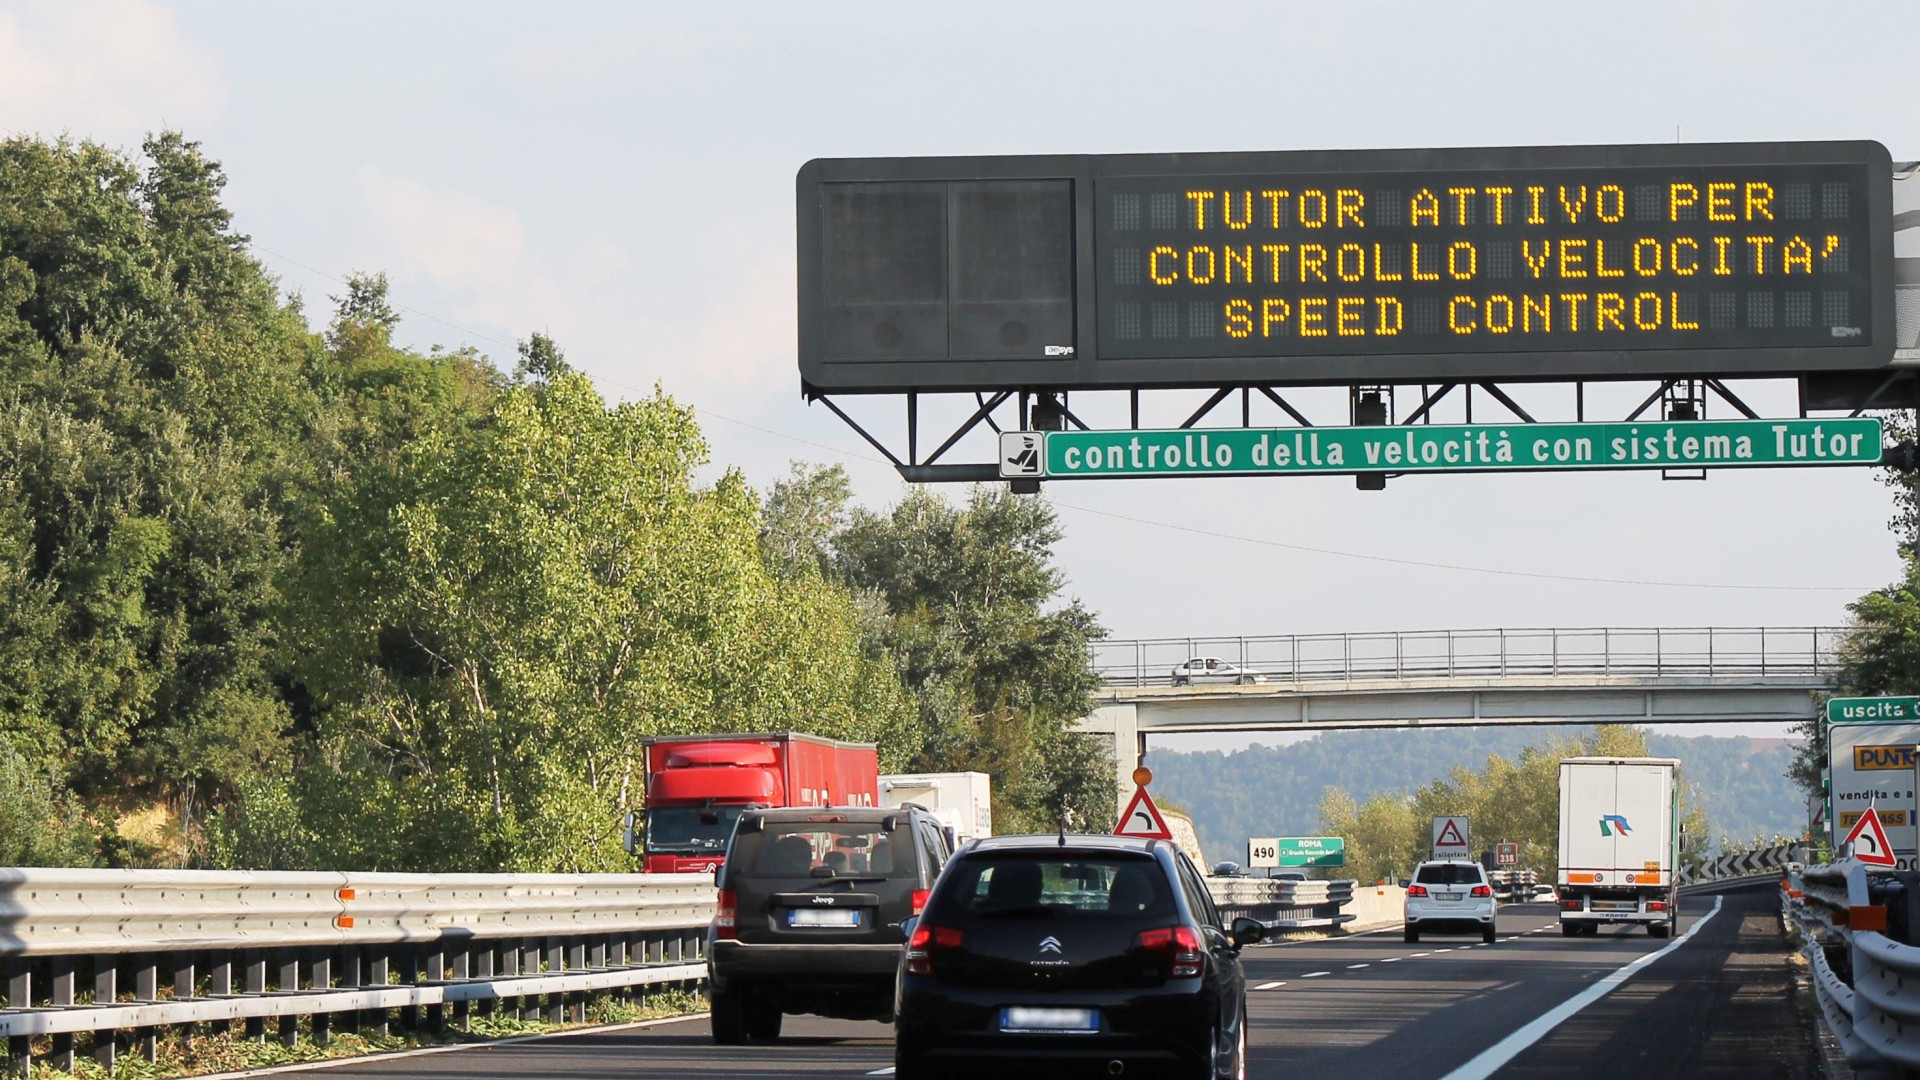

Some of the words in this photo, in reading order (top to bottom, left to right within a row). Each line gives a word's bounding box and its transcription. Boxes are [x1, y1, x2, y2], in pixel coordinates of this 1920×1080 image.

[1186, 188, 1365, 230] TUTOR
[1411, 184, 1625, 227] ATTIVO
[1670, 182, 1774, 222] PER
[1150, 241, 1477, 286] CONTROLLO
[1225, 296, 1403, 338] SPEED
[1449, 292, 1699, 335] CONTROL
[1064, 435, 1233, 470] controllo
[1252, 433, 1344, 466] della
[1364, 430, 1513, 464] velocità
[1532, 438, 1592, 461] con
[1611, 428, 1753, 460] sistema
[1772, 425, 1863, 458] Tutor
[1843, 702, 1904, 718] uscita
[1838, 789, 1888, 800] vendita
[1893, 790, 1901, 799] e
[1298, 839, 1323, 848] ROMA
[1253, 847, 1275, 859] 490
[1500, 854, 1515, 863] 338
[812, 896, 835, 905] Jeep
